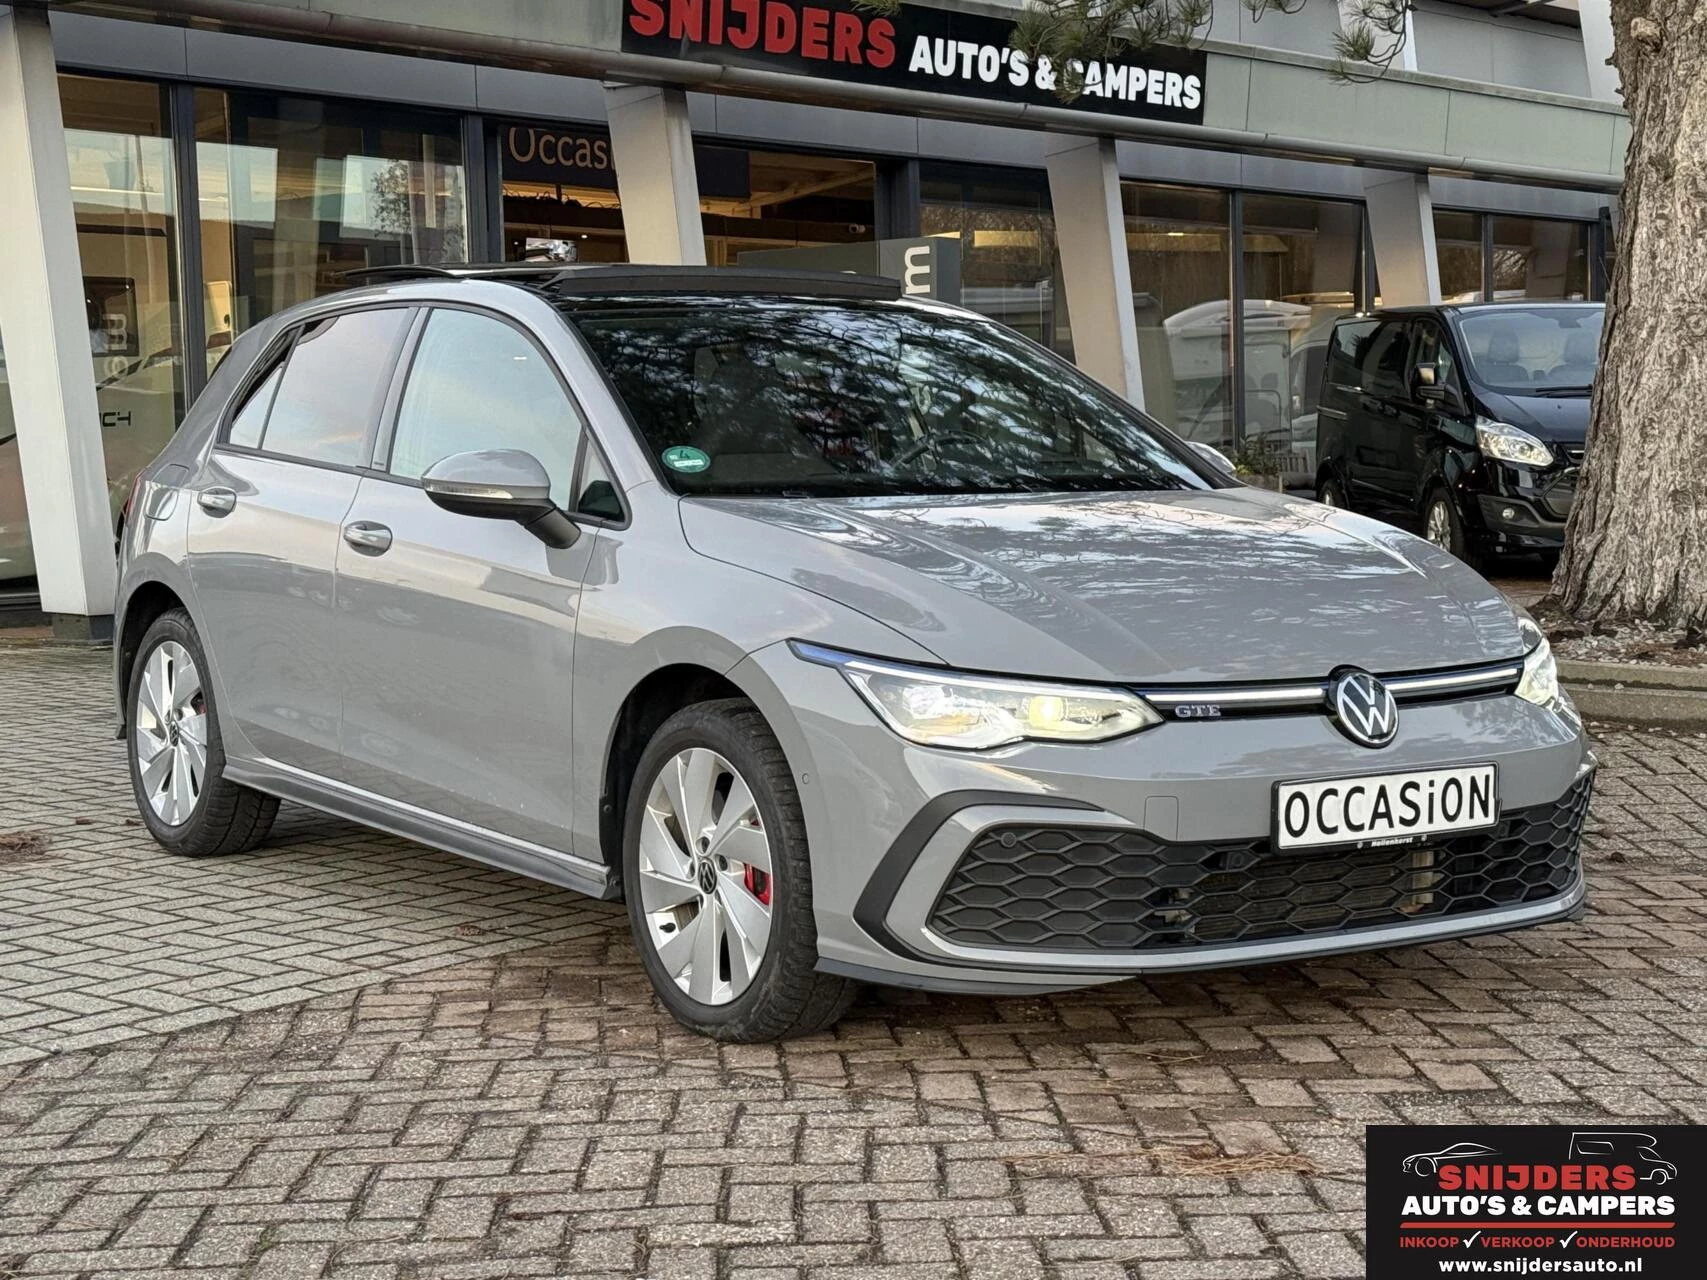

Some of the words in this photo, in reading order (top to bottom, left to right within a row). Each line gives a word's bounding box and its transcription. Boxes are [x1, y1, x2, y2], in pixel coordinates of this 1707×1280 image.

[630, 0, 896, 68] SNIJDERS
[908, 35, 1029, 87] AUTO'S
[1035, 54, 1057, 91] &
[509, 127, 616, 170] Occas
[1174, 704, 1222, 718] GTE
